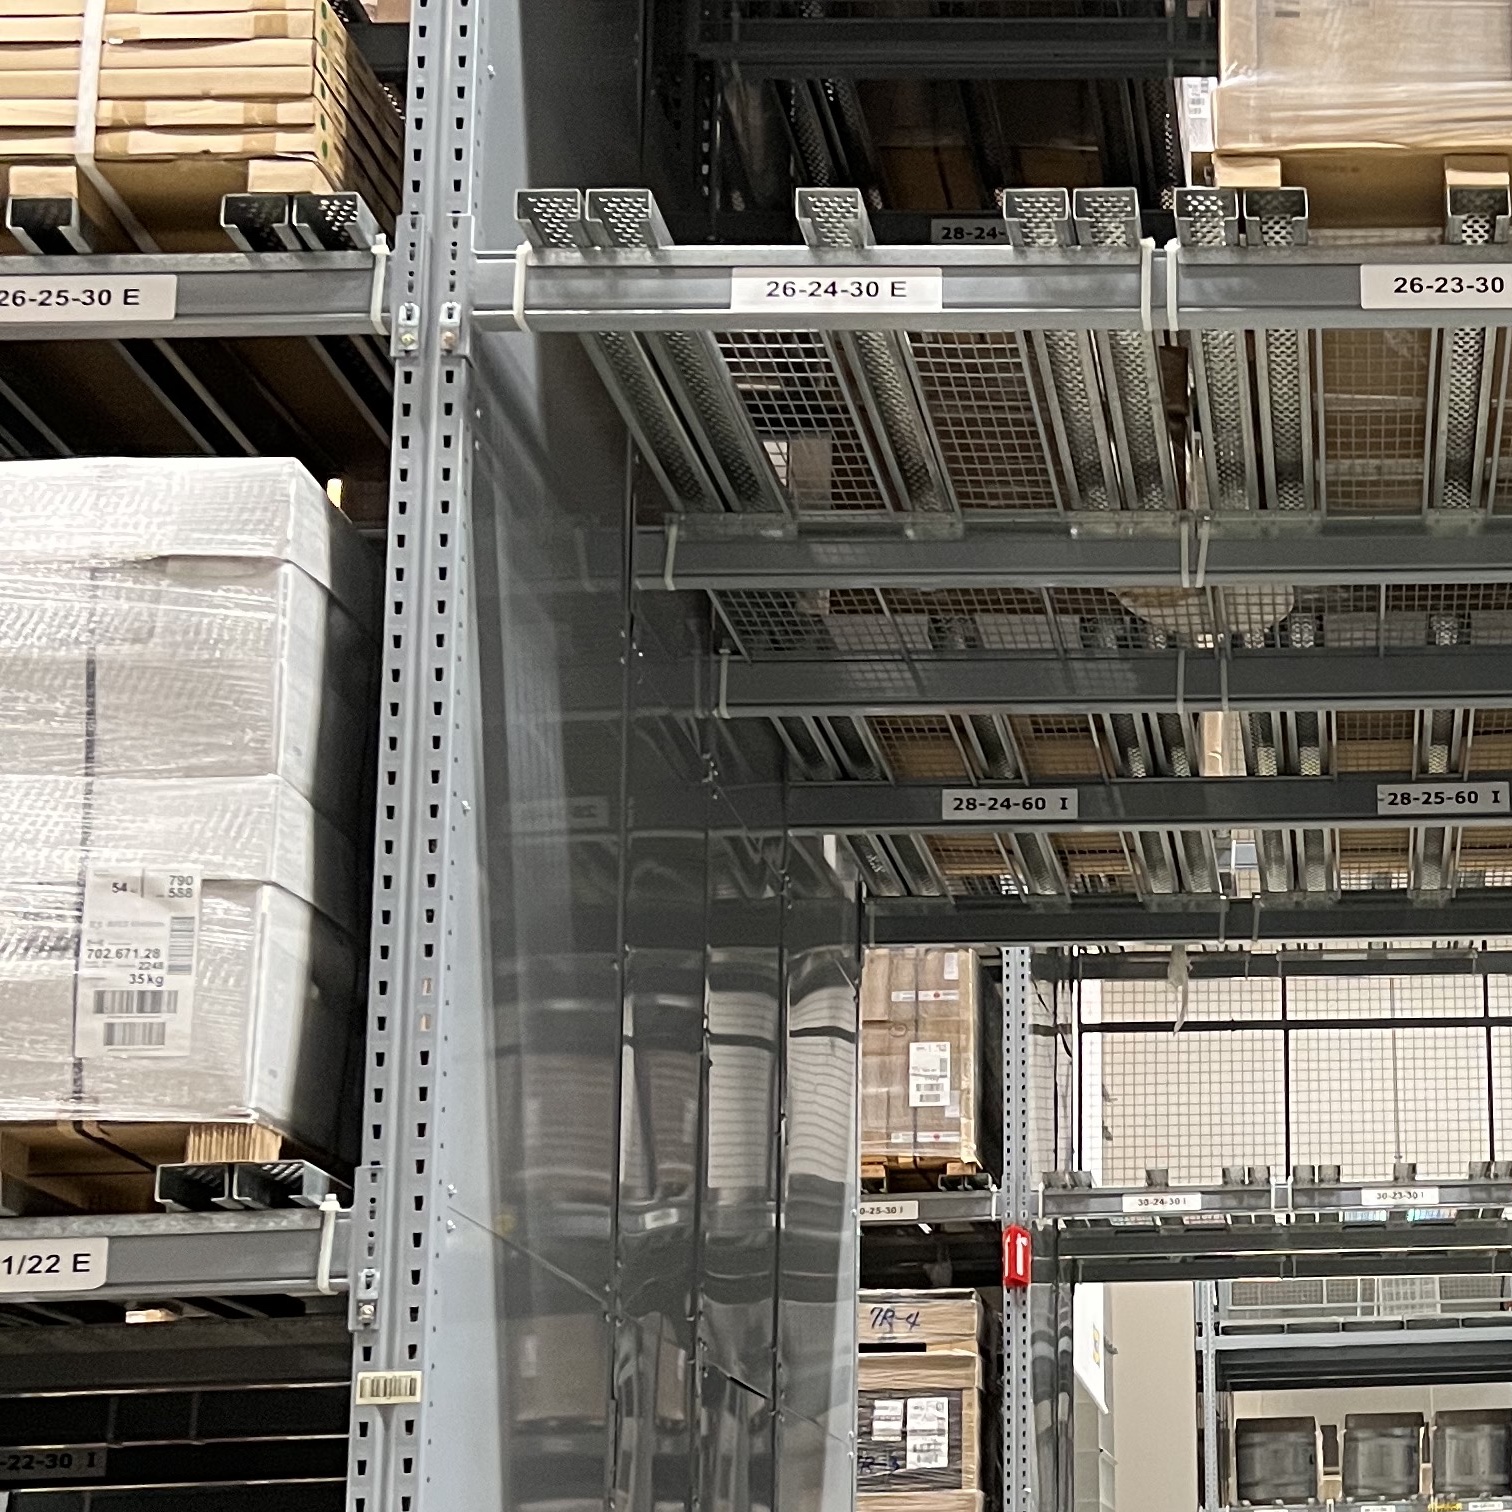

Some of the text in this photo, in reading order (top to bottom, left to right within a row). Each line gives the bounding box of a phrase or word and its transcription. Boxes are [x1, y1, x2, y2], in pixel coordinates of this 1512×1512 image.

[766, 280, 907, 298] 26-24-30 E
[1393, 276, 1505, 294] 26-23-30
[0, 288, 140, 307] 26-25-30 E
[953, 797, 1068, 811] 28-24-60 I
[1387, 790, 1500, 806] 28-25-60 I
[112, 882, 128, 894] 54
[169, 874, 194, 886] 790
[72, 1253, 91, 1273] E
